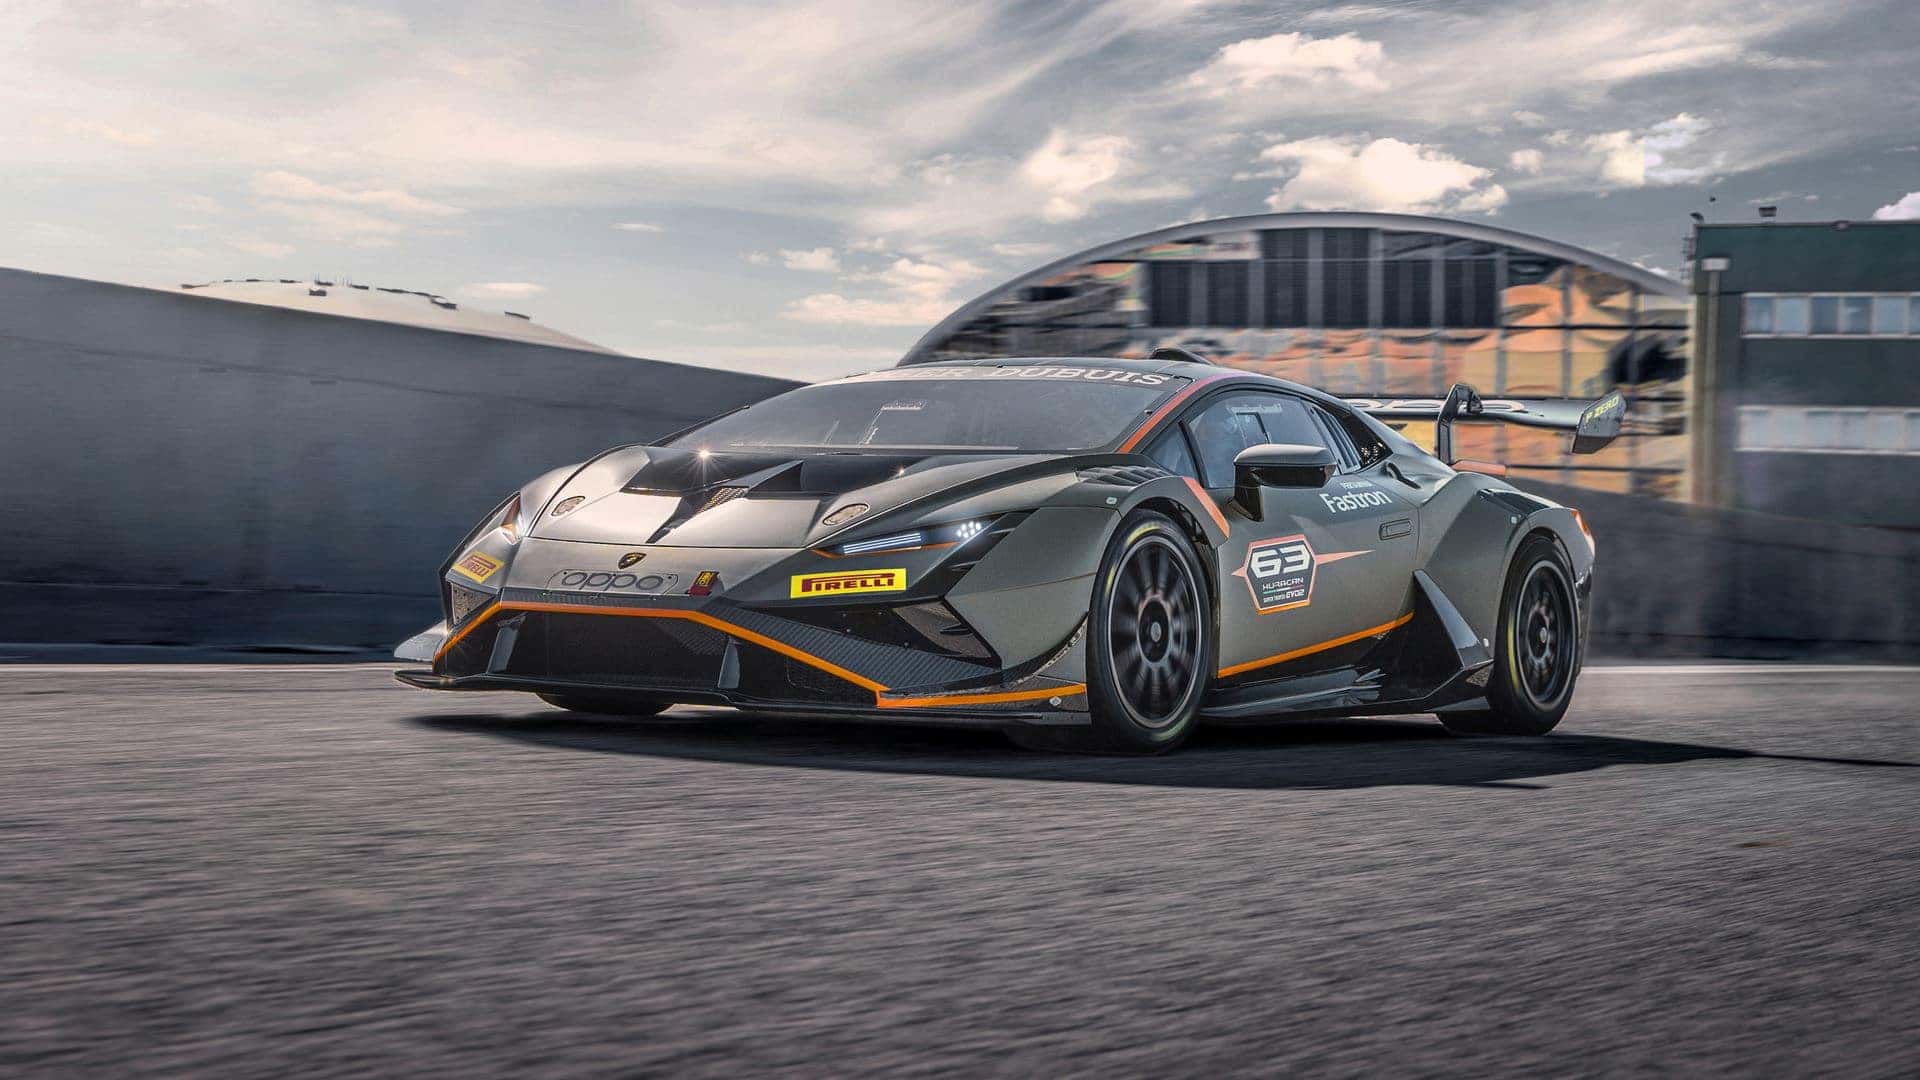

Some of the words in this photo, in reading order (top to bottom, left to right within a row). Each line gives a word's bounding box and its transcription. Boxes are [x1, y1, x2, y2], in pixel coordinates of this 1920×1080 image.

[985, 366, 1169, 385] DUBUIS
[1319, 490, 1393, 513] Fastron
[1250, 543, 1311, 579] 63
[561, 571, 664, 592] oppo
[801, 572, 896, 593] PIRELLI
